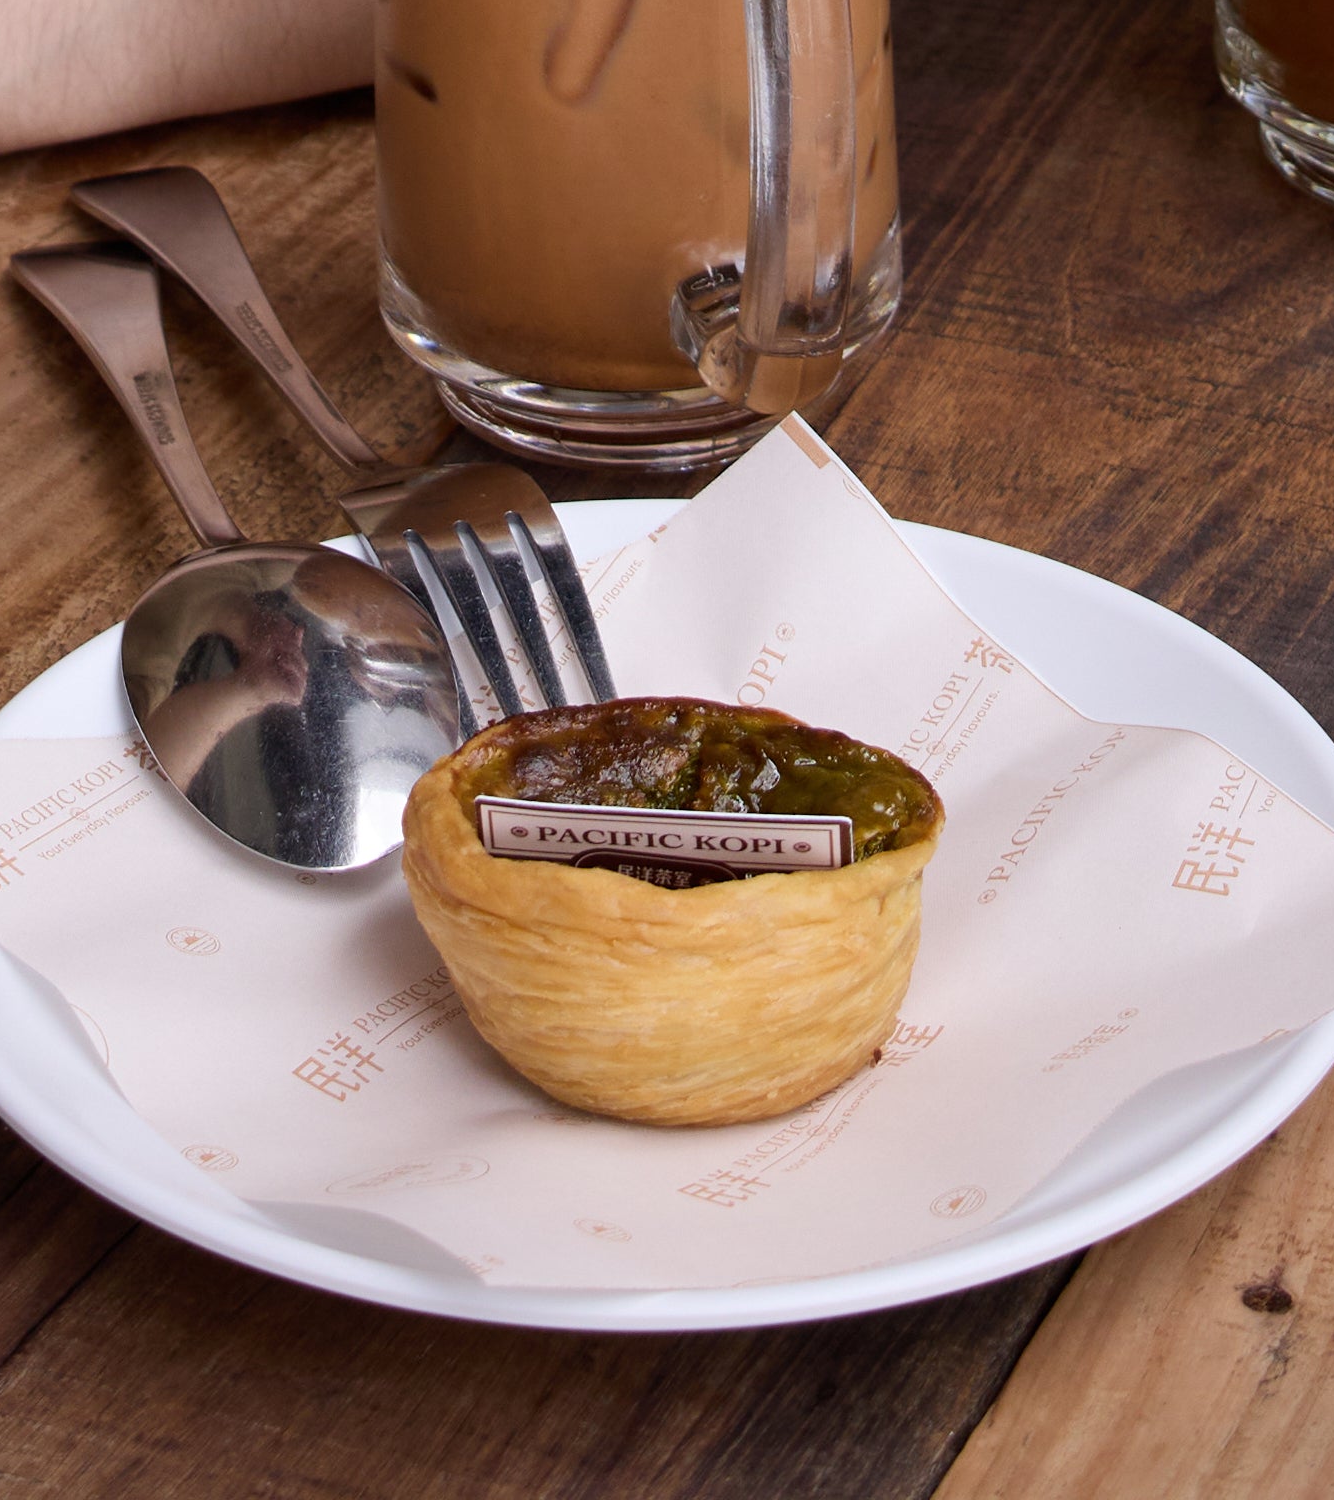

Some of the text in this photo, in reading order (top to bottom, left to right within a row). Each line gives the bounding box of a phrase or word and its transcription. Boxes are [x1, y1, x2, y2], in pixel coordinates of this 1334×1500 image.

[922, 670, 970, 737] KOPI
[71, 759, 126, 799] KOPI
[930, 740, 967, 786] veryday
[36, 787, 155, 862] Your Everyday Flavours.
[535, 825, 788, 855] PACIFIC KOPI
[985, 777, 1080, 884] PACIFIC
[1171, 821, 1256, 897] 民洋
[352, 982, 431, 1035] PACIFIC
[291, 1031, 385, 1102] 民洋
[396, 1029, 425, 1052] Your
[733, 1117, 813, 1169] PACIFIC
[677, 1168, 771, 1208] 民洋
